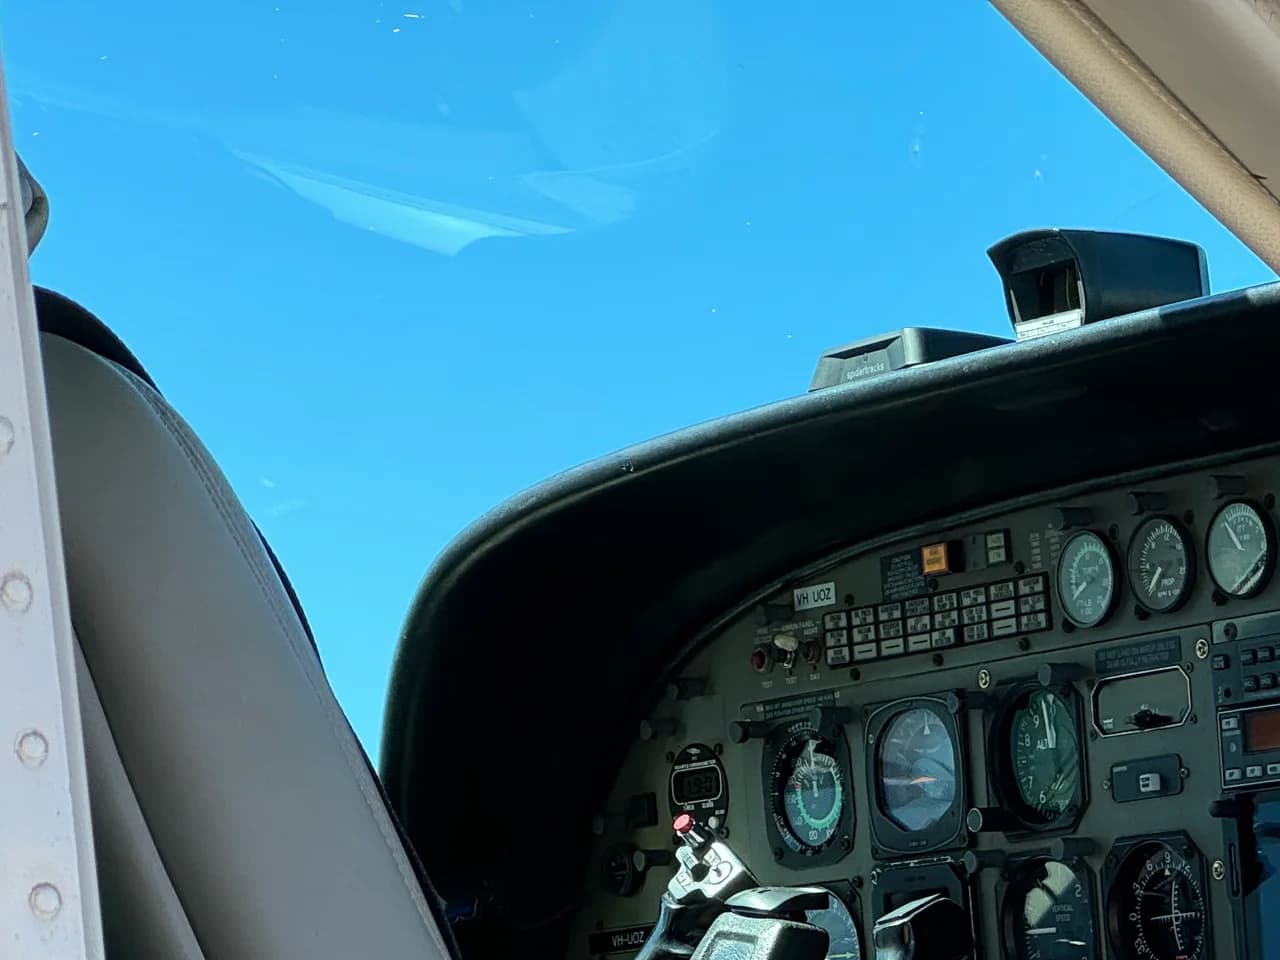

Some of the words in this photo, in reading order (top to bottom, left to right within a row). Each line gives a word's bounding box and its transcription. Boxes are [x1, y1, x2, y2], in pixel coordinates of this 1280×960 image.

[796, 592, 809, 606] VH
[812, 588, 831, 603] UOZ
[1032, 714, 1040, 728] 9
[1024, 734, 1030, 746] 8
[1028, 776, 1033, 789] 7
[1040, 790, 1046, 804] 6
[1164, 852, 1171, 864] 9
[611, 930, 645, 947] VH-UOZ
